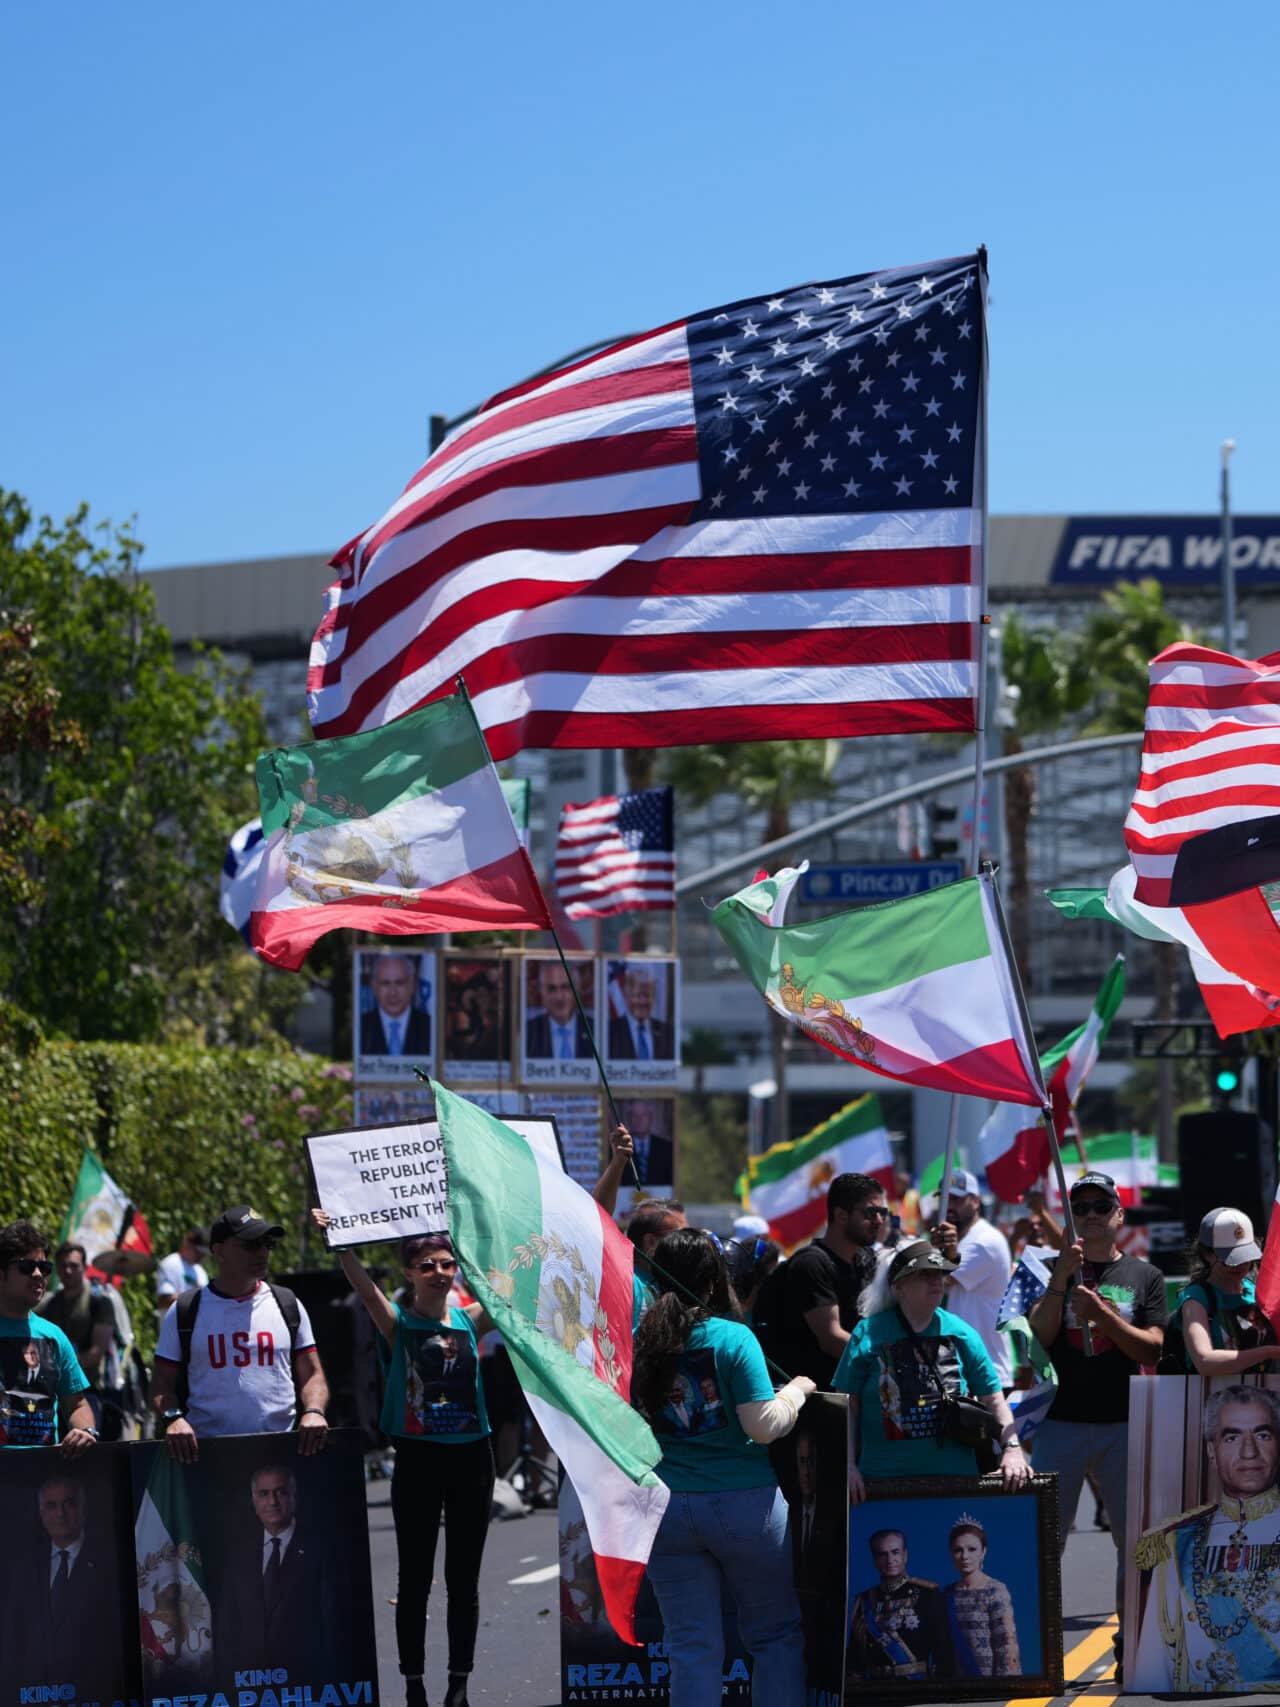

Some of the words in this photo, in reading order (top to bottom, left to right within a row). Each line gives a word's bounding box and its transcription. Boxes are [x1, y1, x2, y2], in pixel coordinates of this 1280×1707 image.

[1068, 535, 1172, 569] FIFA
[840, 872, 920, 895] Pincay
[929, 868, 955, 889] Dr
[527, 1062, 556, 1078] Best
[560, 1062, 591, 1080] King
[349, 1150, 380, 1165] THE
[390, 1182, 436, 1200] TEAM
[328, 1205, 420, 1232] REPRESENT
[422, 1199, 447, 1217] TH
[207, 1331, 274, 1369] USA
[234, 1668, 288, 1688] KING
[568, 1662, 645, 1688] REZA
[20, 1683, 76, 1704] KING
[569, 1688, 672, 1700] ALTERNATI
